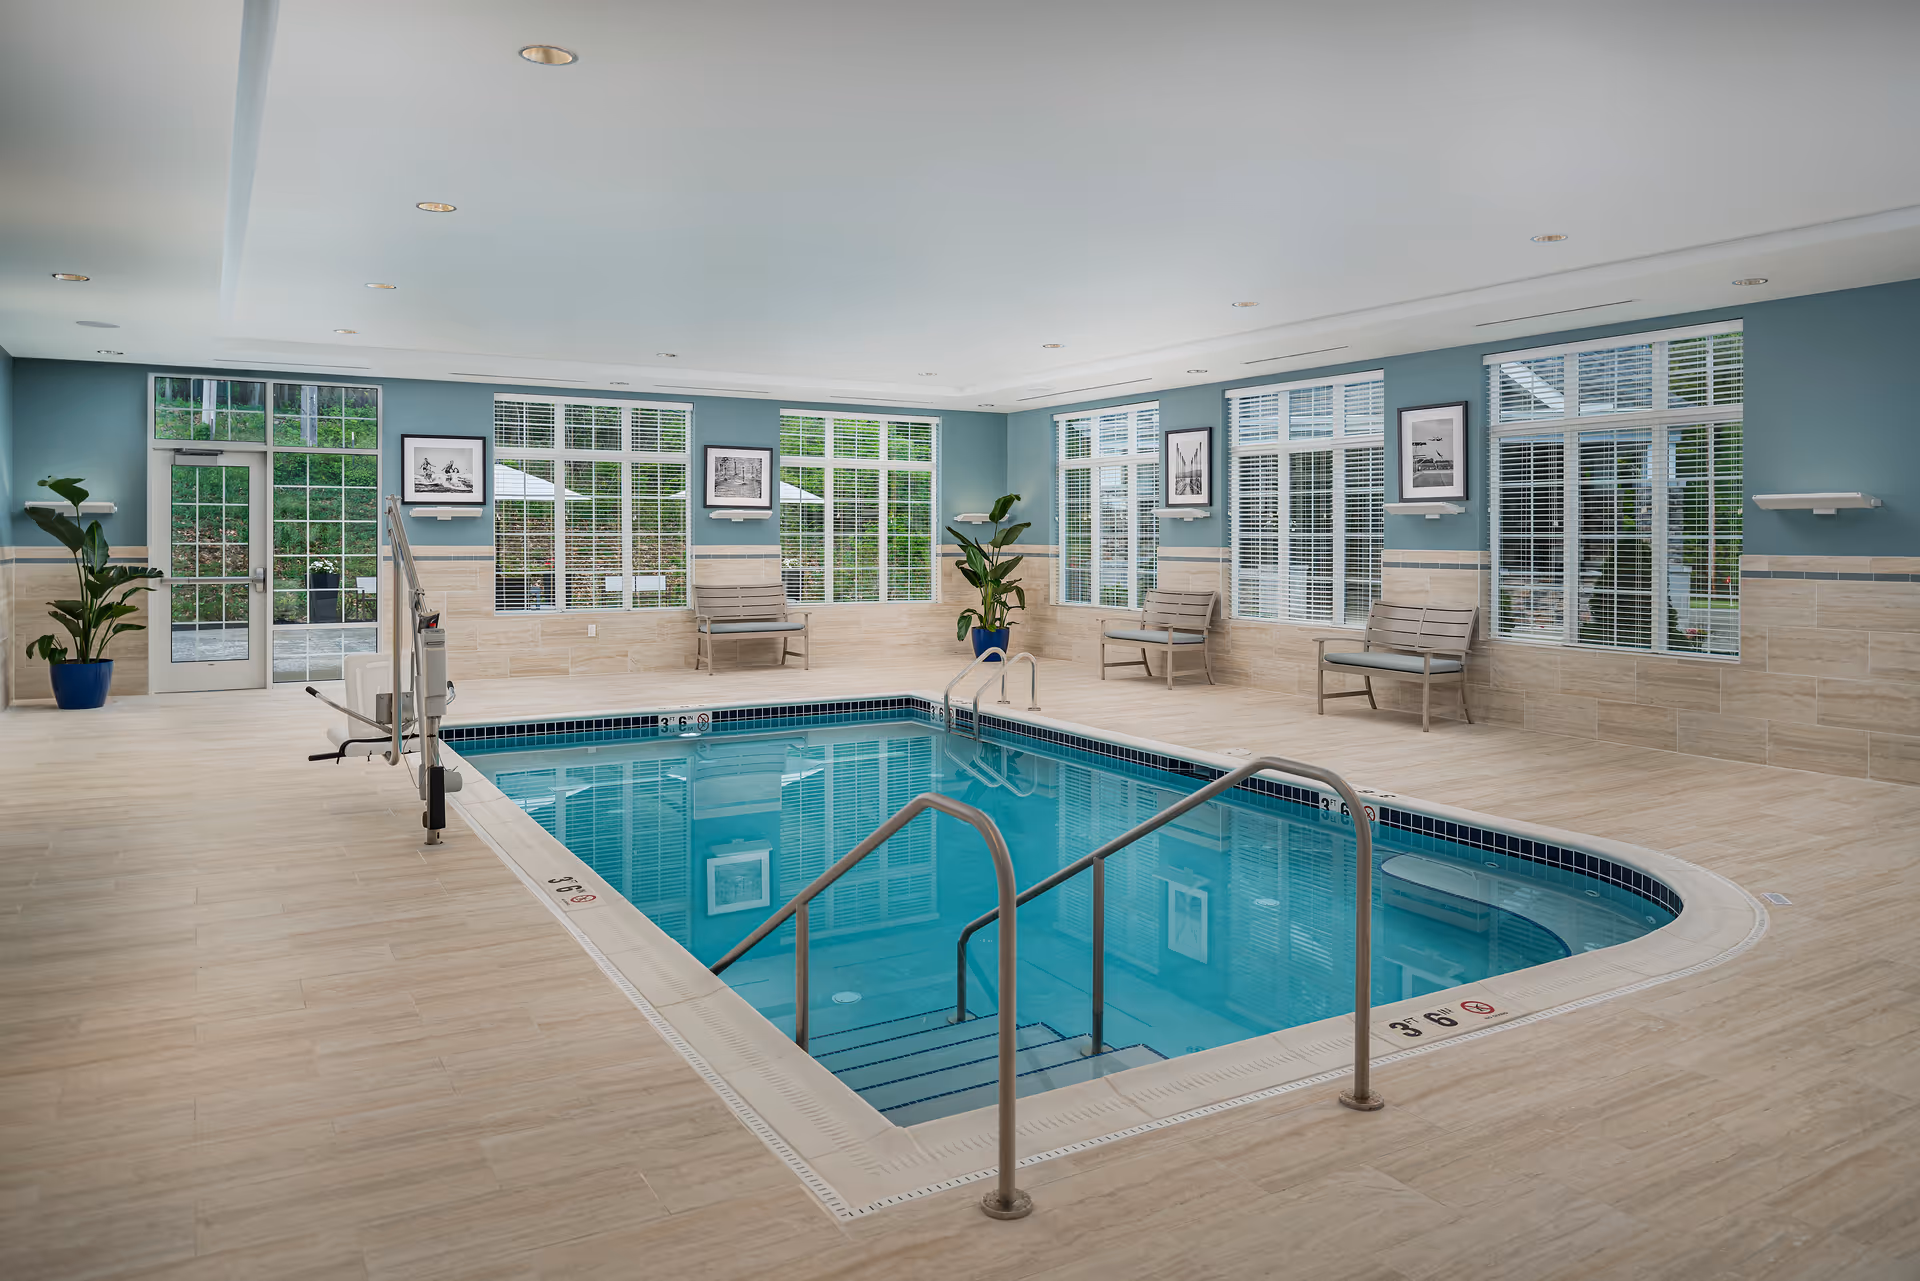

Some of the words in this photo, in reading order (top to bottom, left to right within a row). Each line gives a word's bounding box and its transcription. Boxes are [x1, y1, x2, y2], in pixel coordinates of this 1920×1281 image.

[661, 718, 668, 728] 3
[679, 716, 687, 727] 6
[1321, 797, 1330, 812] 3
[1388, 1022, 1423, 1037] 3
[1423, 1012, 1459, 1027] 6
